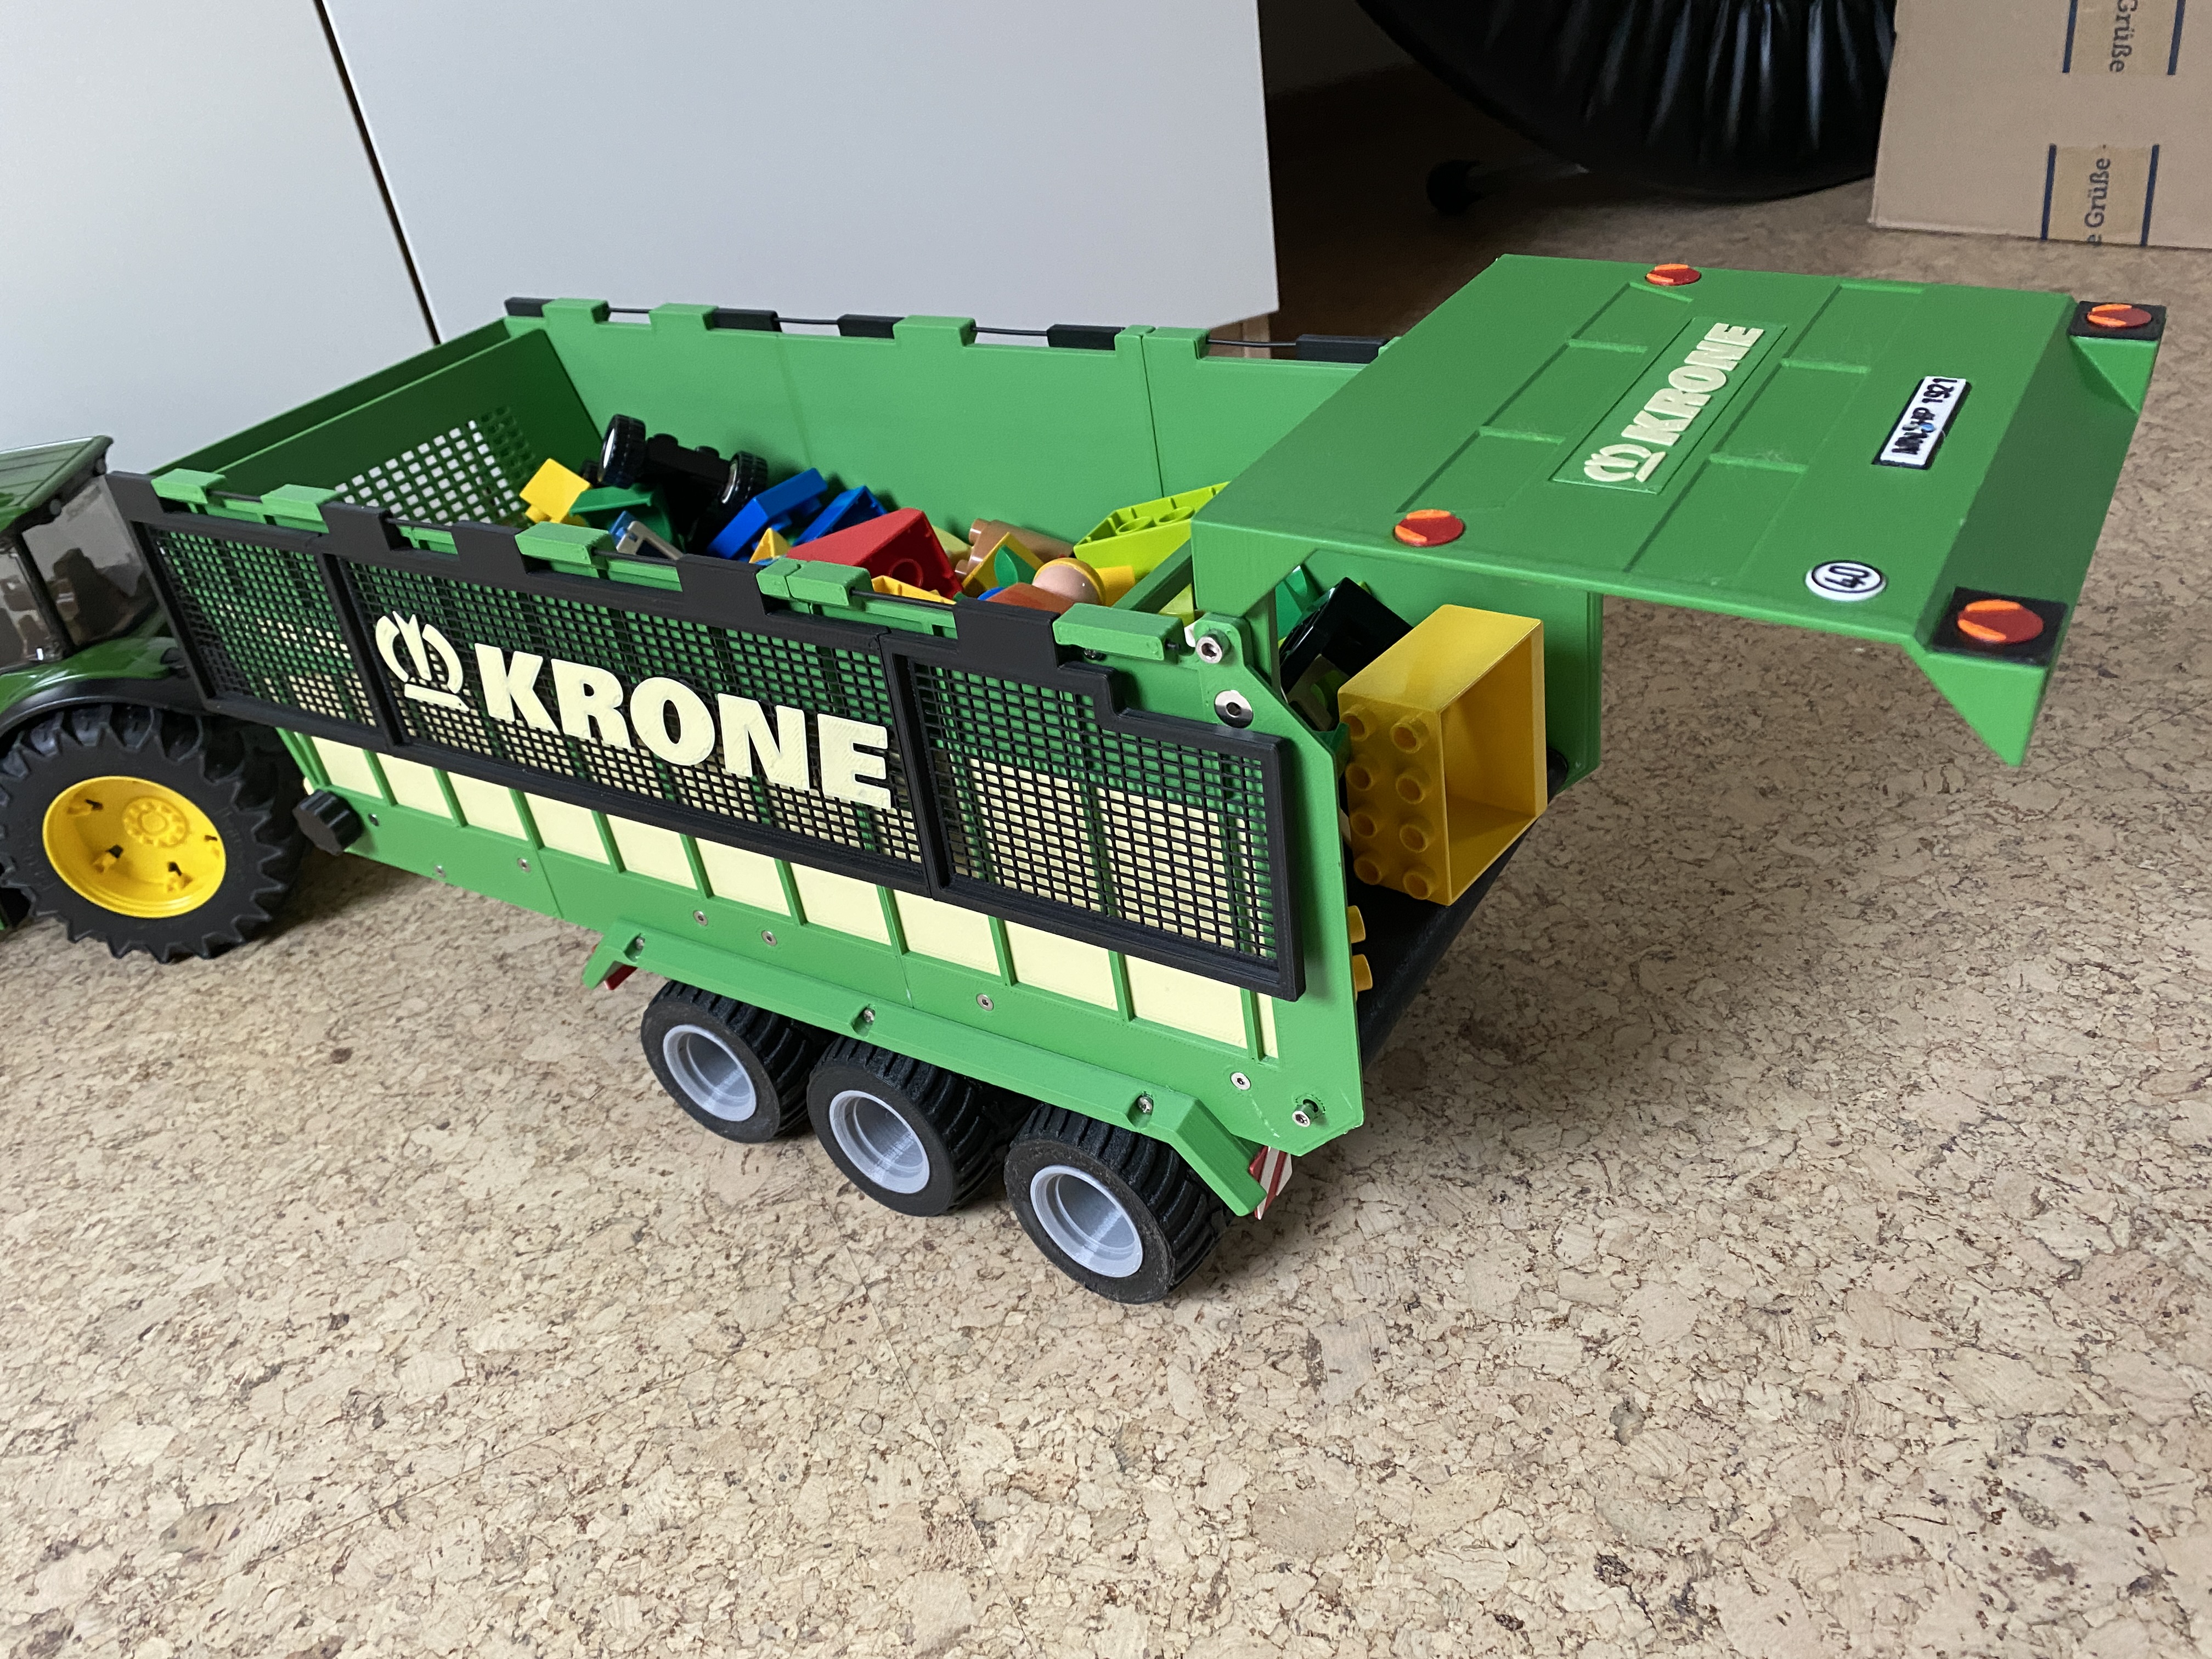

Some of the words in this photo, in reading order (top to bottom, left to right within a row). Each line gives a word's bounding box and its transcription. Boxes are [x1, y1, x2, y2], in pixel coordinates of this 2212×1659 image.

[2109, 0, 2138, 72] Grüße
[2085, 158, 2111, 228] Grüße
[1621, 323, 1764, 446] KRONE
[1824, 565, 1870, 588] 40
[475, 642, 891, 810] KRONE
